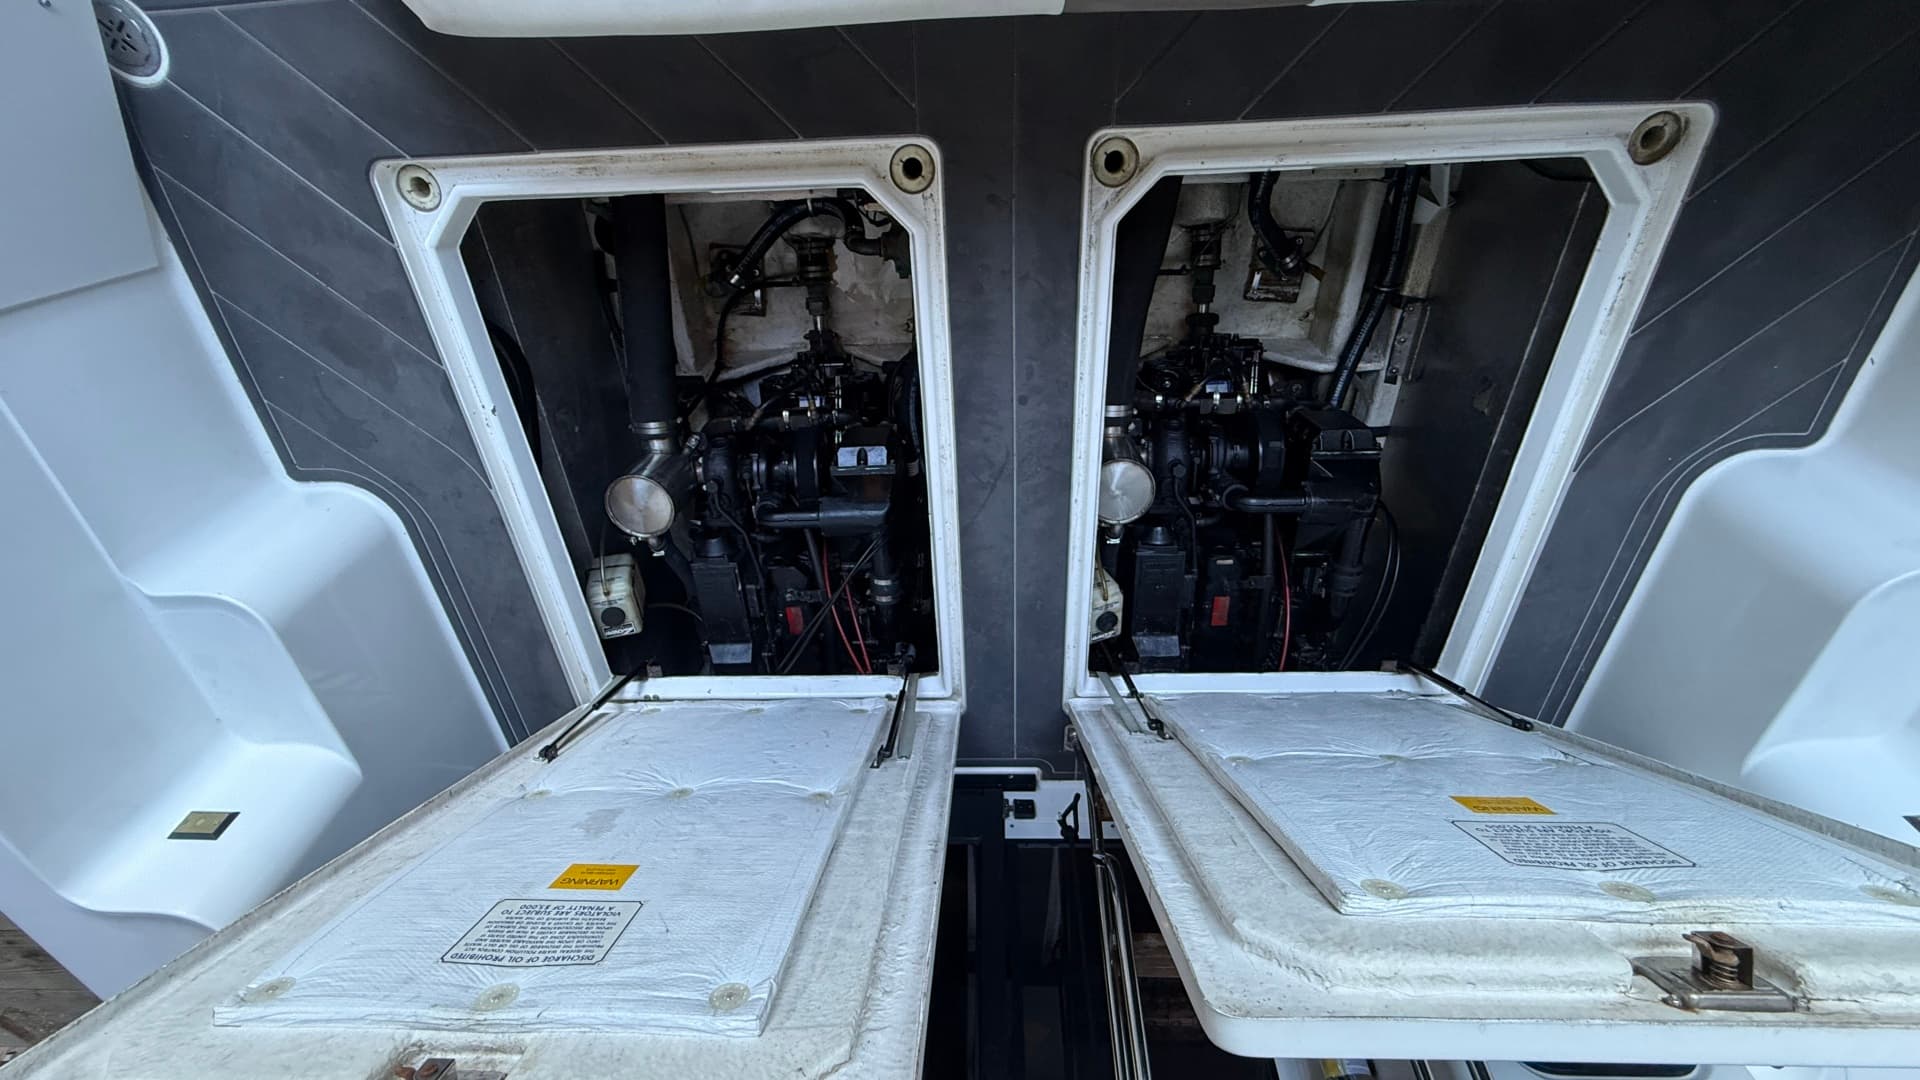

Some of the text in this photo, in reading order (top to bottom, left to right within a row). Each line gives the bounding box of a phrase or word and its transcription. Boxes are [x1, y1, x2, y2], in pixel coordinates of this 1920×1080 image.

[559, 878, 619, 886] WARNING
[450, 953, 505, 962] PROHIBITED
[542, 954, 595, 962] DISCHARGE
